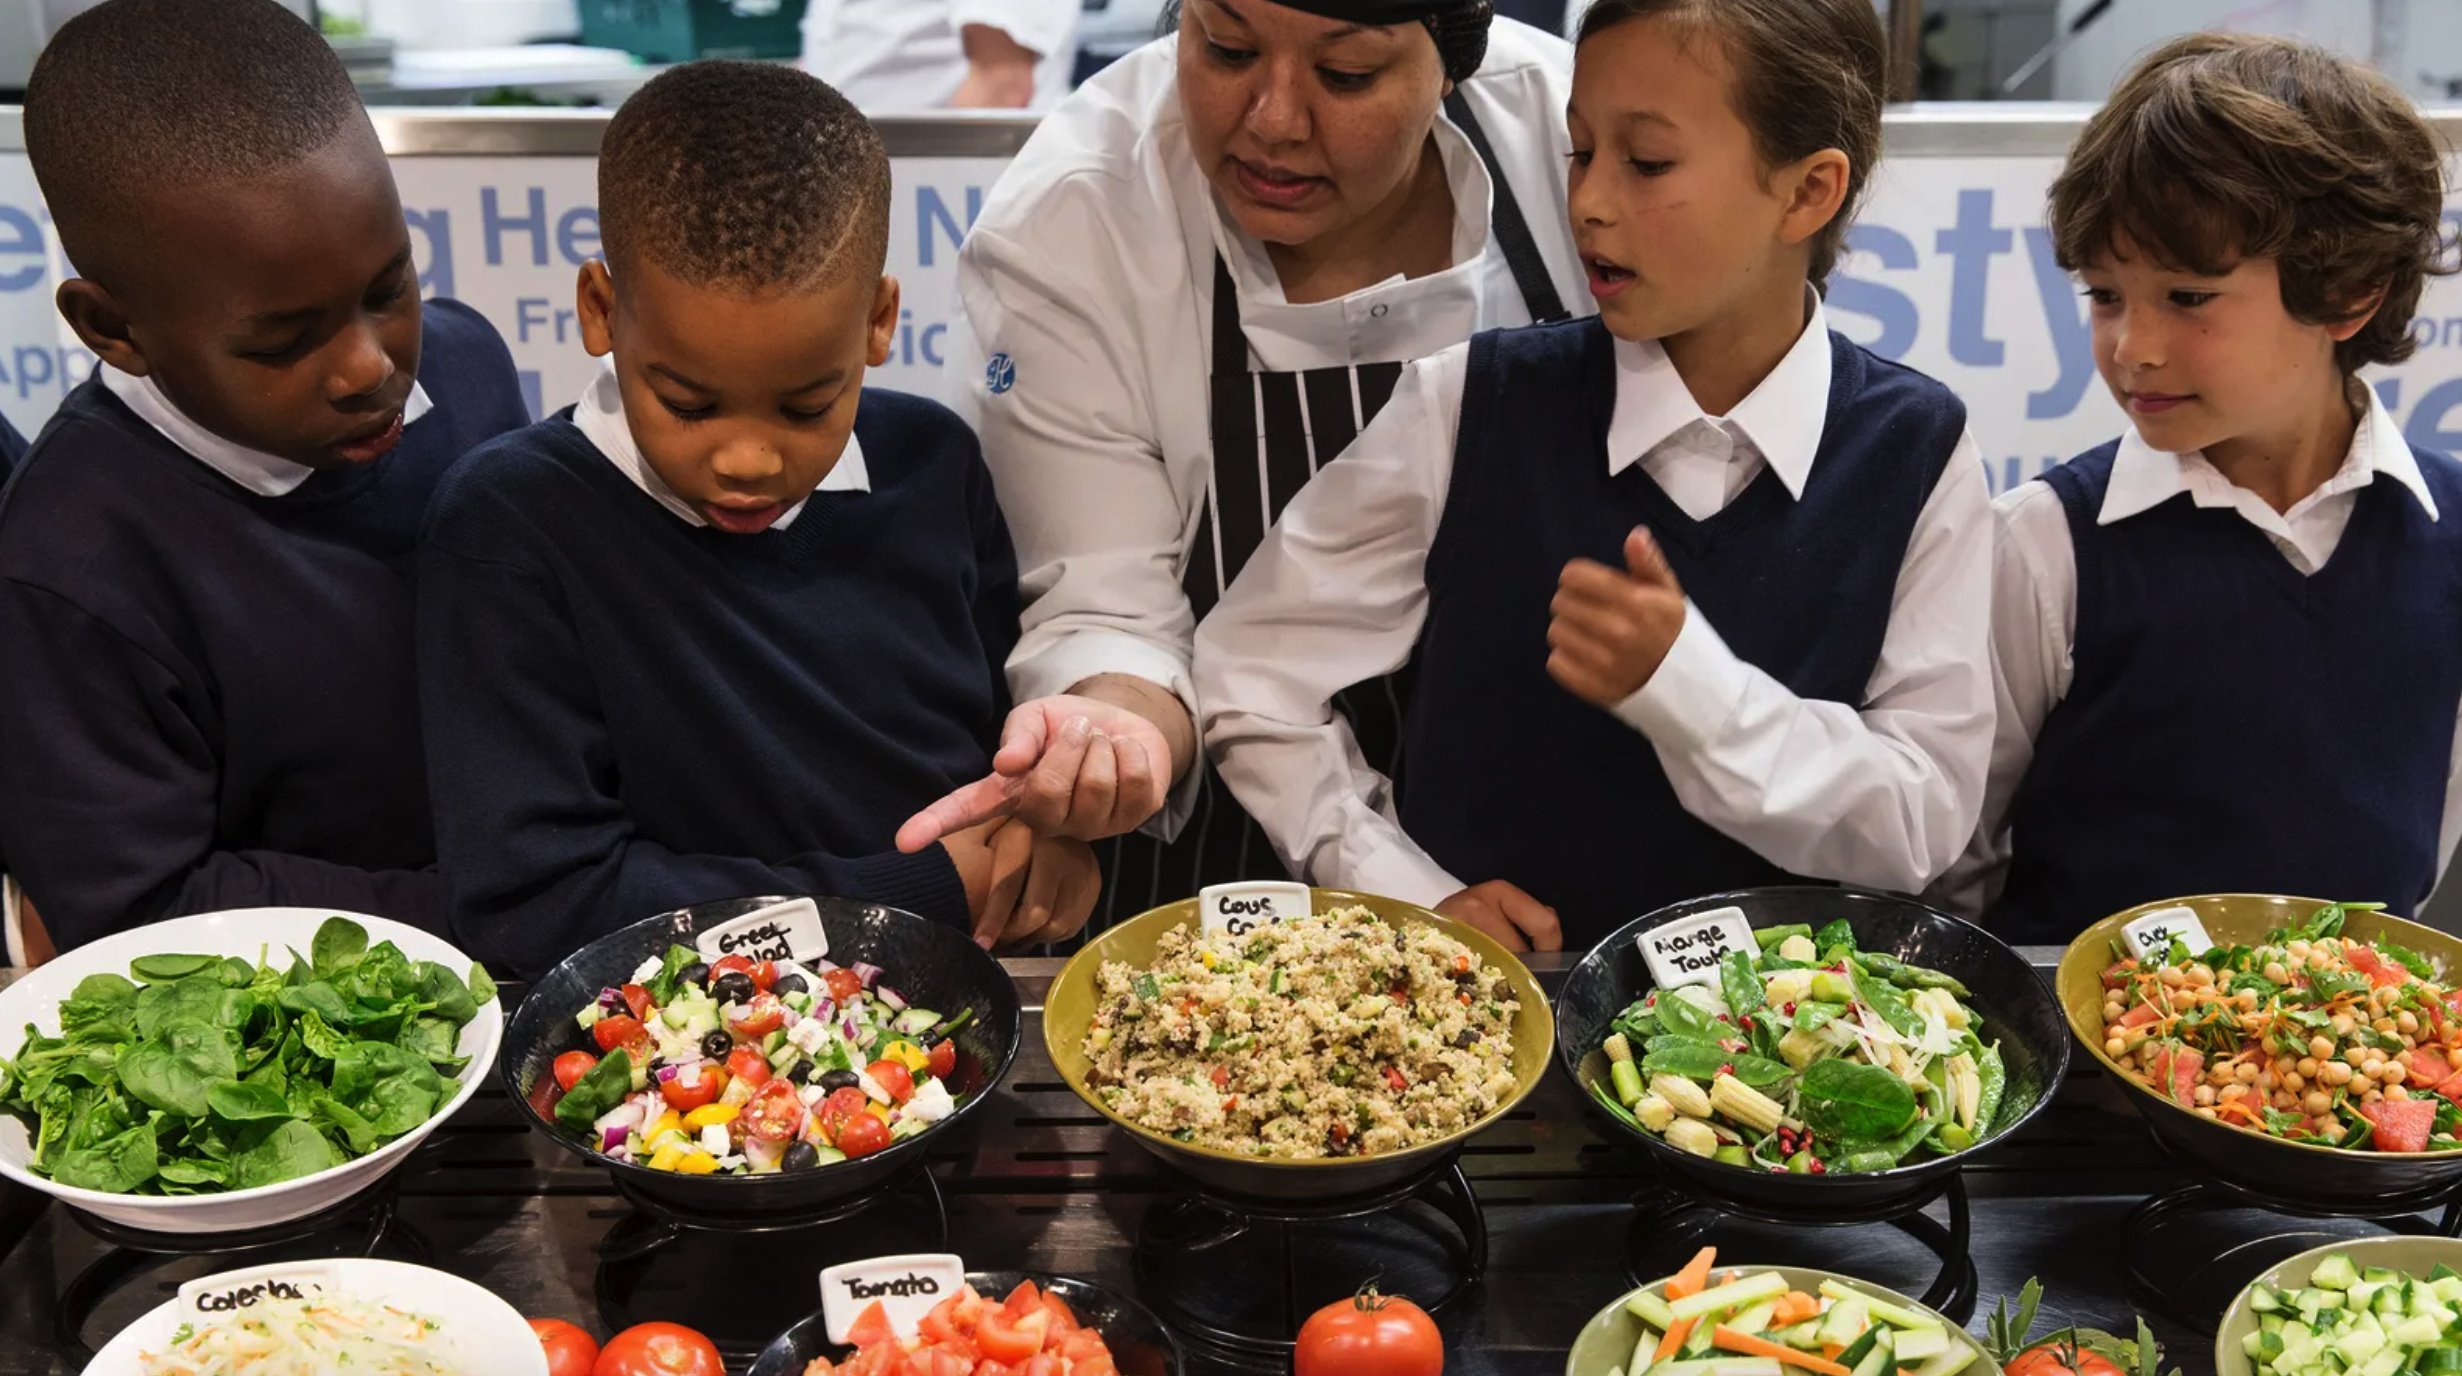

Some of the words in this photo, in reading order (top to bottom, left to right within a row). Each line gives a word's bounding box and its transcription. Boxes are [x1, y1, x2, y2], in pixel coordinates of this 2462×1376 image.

[480, 186, 605, 268] He
[916, 186, 982, 268] N
[516, 298, 584, 343] Fr
[1824, 188, 2098, 420] sty
[885, 308, 947, 367] ic
[2412, 315, 2462, 348] on
[1219, 896, 1276, 917] Cous
[1654, 925, 1726, 955] Mange
[841, 1271, 940, 1300] Tomato
